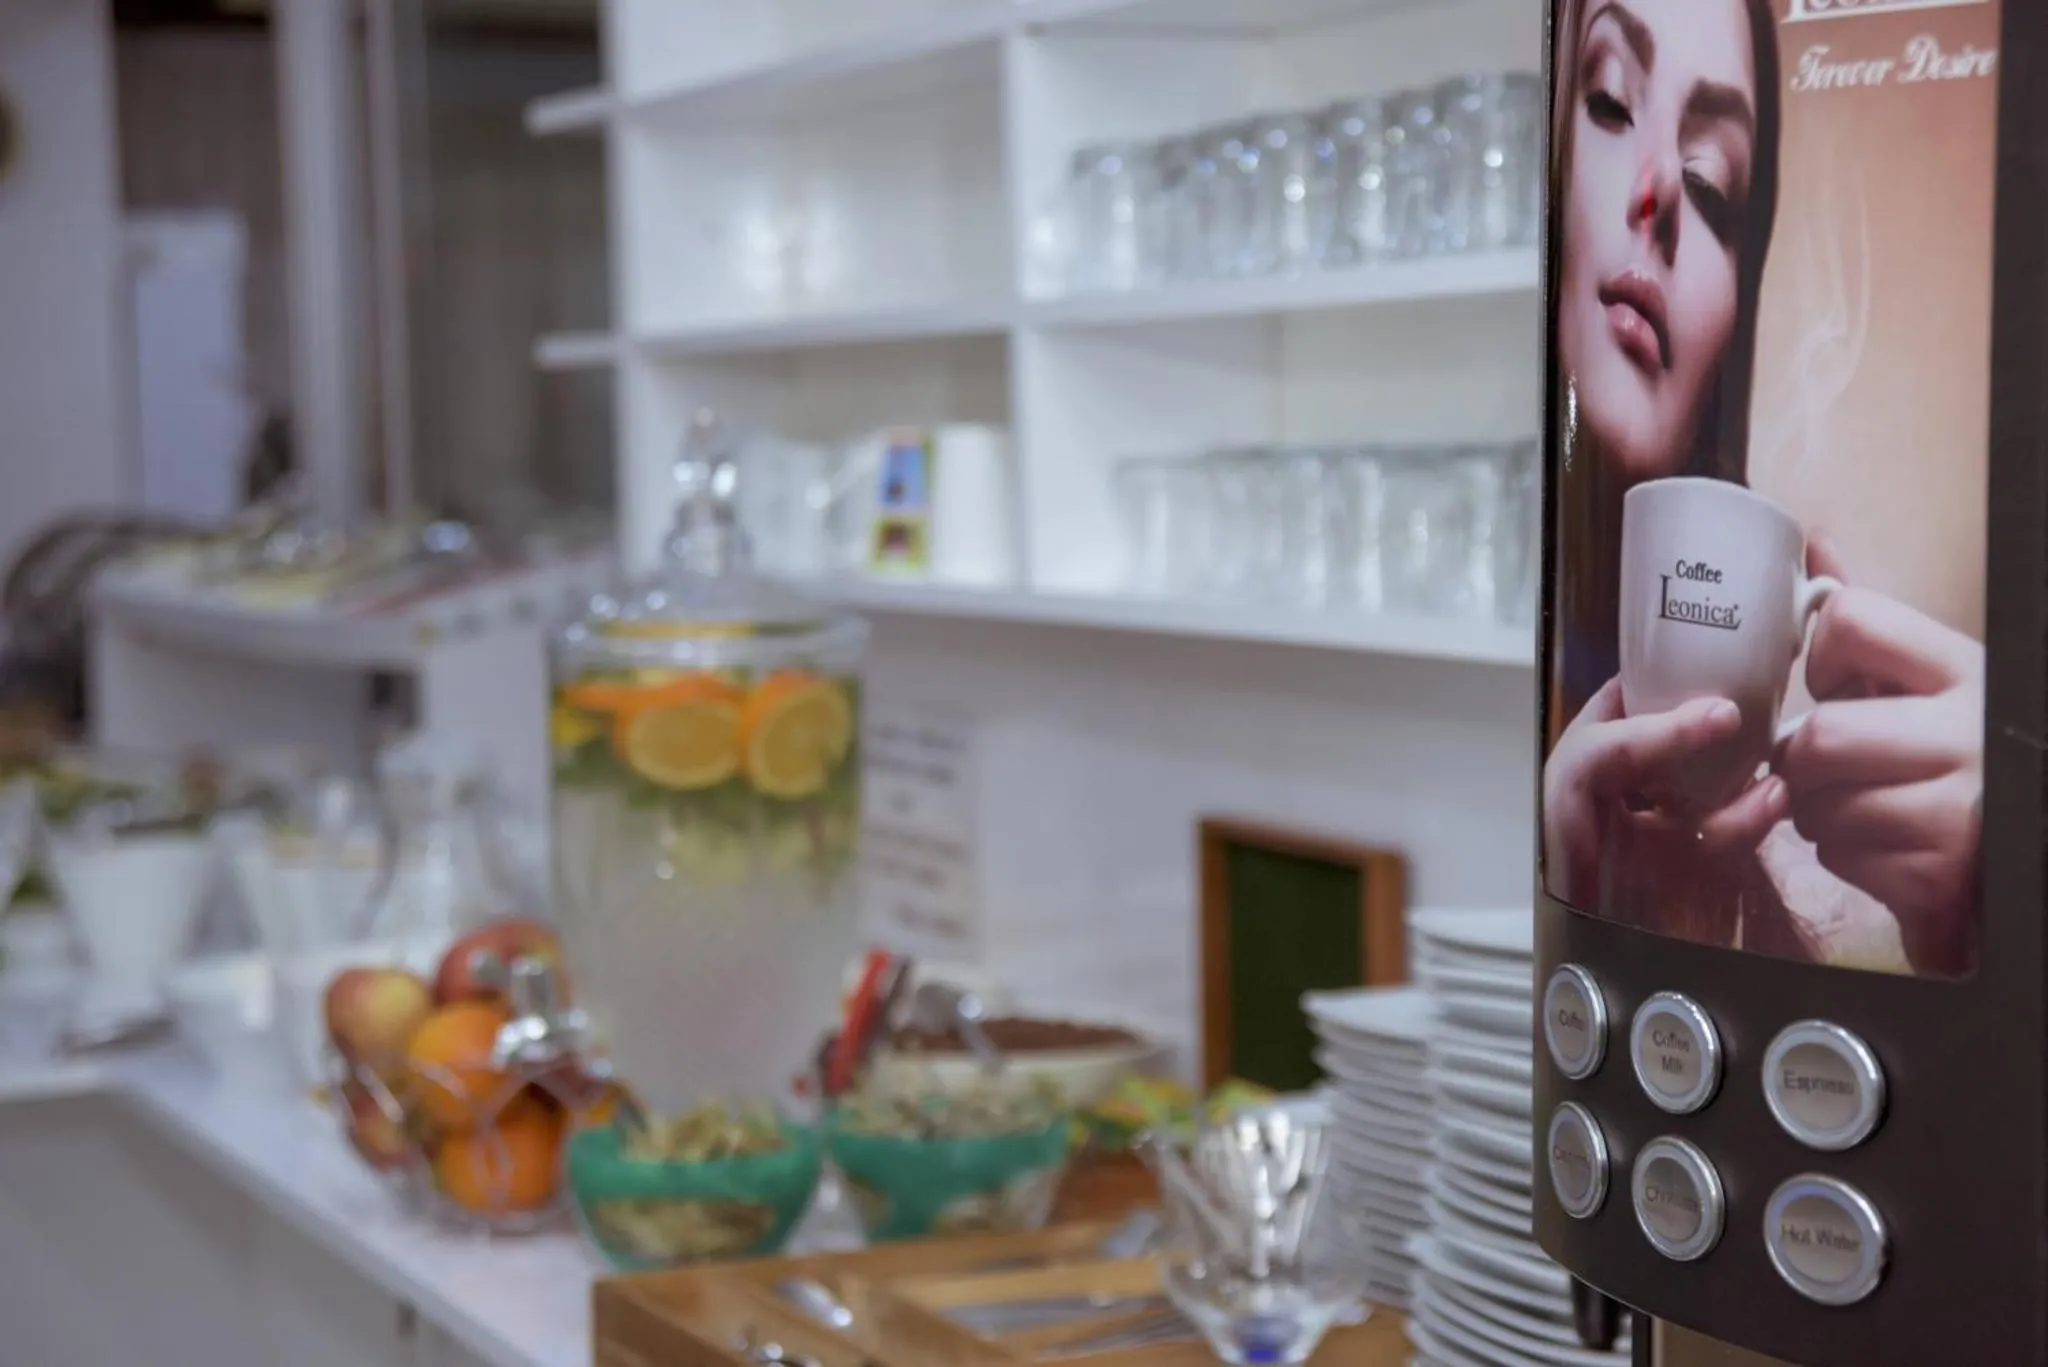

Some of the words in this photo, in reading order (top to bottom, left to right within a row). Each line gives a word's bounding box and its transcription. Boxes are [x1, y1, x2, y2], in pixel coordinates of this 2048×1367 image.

[1897, 32, 1998, 83] Desire
[1675, 559, 1722, 583] Coffee
[1652, 1029, 1690, 1053] Coffee
[1661, 1055, 1684, 1075] Milk
[1783, 1069, 1855, 1096] Espresso
